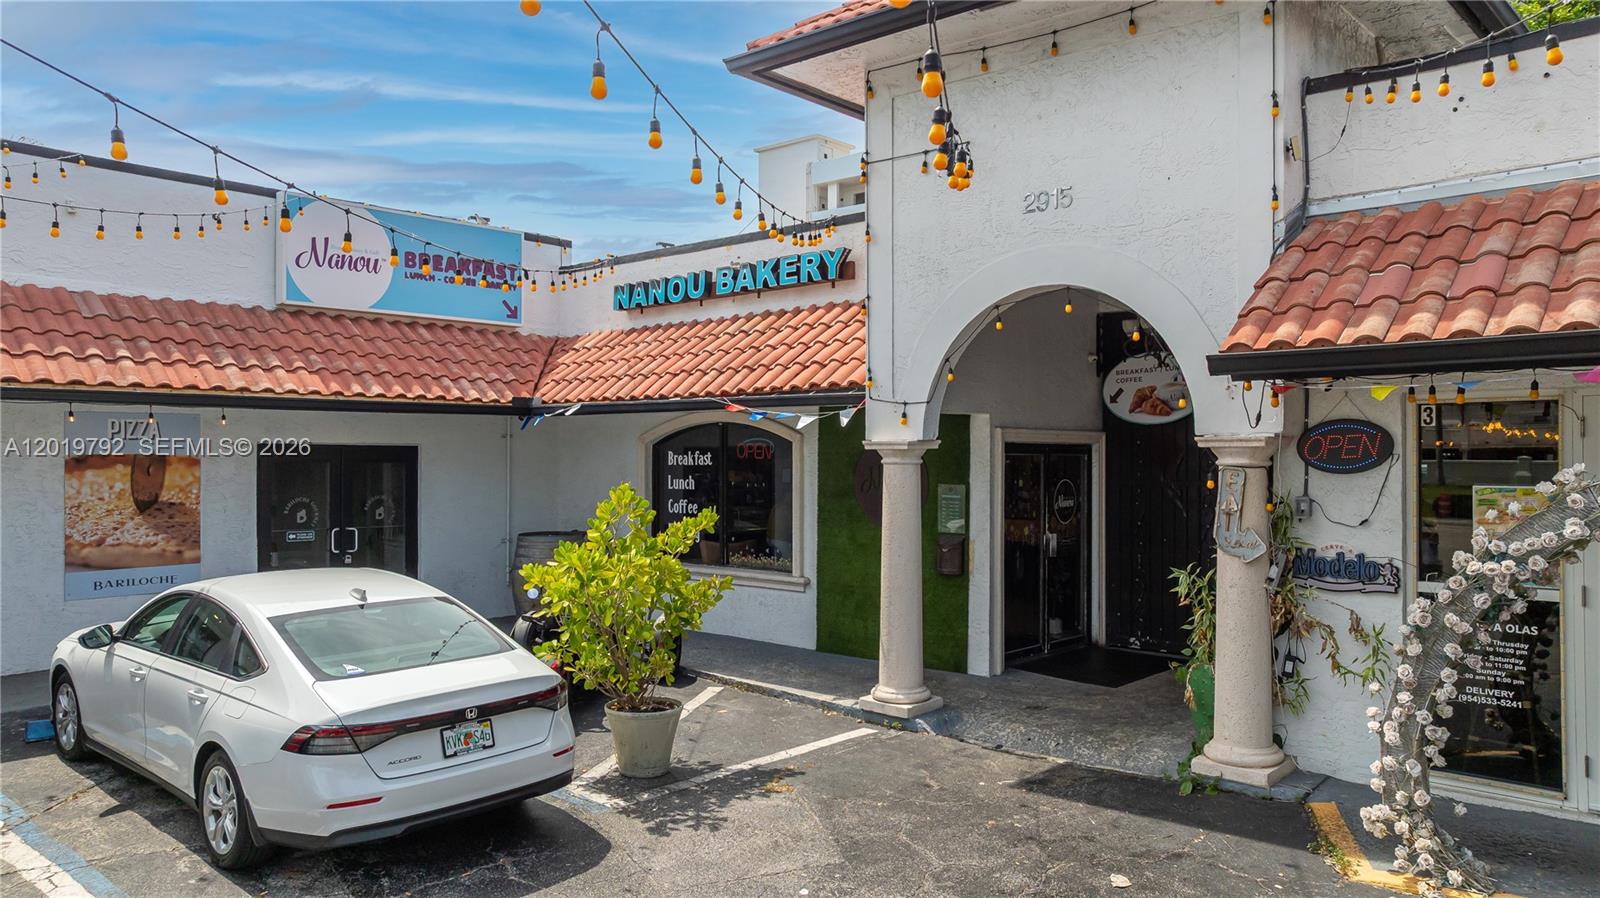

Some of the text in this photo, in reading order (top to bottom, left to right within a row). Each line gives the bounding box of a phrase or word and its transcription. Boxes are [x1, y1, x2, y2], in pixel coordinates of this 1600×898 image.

[1022, 186, 1074, 214] 2915
[295, 236, 382, 274] Nanou
[404, 251, 518, 281] BREAKFAST
[613, 247, 850, 311] NANOU BAKERY
[1115, 376, 1143, 384] COFFEE
[1423, 406, 1434, 426] 3
[107, 419, 162, 440] PIZZA
[736, 443, 774, 460] OPEN
[1303, 432, 1382, 460] OPEN
[667, 450, 713, 466] Breakfast
[667, 475, 695, 490] Lunch
[667, 498, 699, 514] Coffee
[1293, 547, 1381, 582] Modelo
[93, 574, 178, 591] BARILOCHE
[1506, 623, 1539, 636] OLAS
[1489, 655, 1524, 665] Saturday
[1516, 648, 1528, 656] pm
[1476, 668, 1507, 677] Sunday
[1496, 676, 1511, 684] 9:00
[1512, 678, 1525, 686] pm
[1466, 686, 1515, 699] DELIVERY
[1458, 693, 1523, 709] (954)533-5241
[445, 732, 464, 750] KVK
[387, 755, 422, 766] ACCORD
